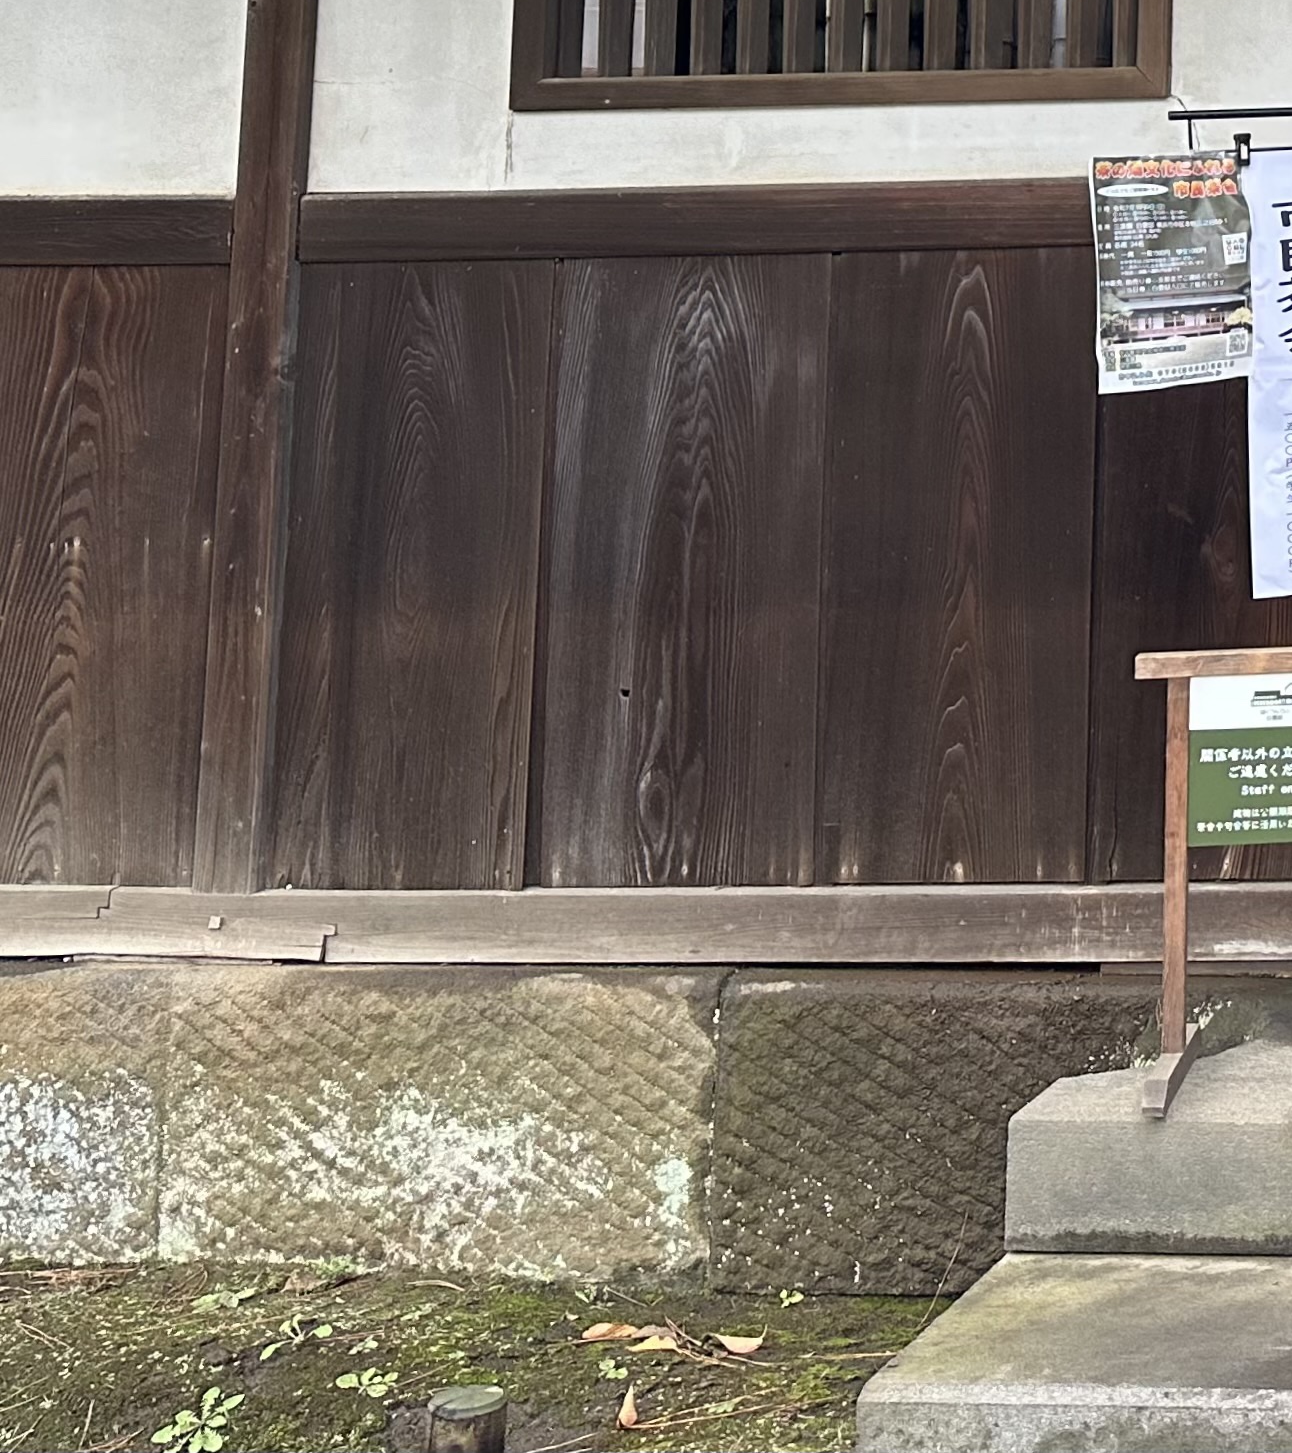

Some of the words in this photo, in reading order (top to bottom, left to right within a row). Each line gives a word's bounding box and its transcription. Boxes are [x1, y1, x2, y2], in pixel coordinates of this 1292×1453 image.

[1095, 158, 1236, 179] 茶の湯文化にふれる
[1173, 178, 1238, 199] 市民茶会
[1241, 784, 1275, 796] Staff
